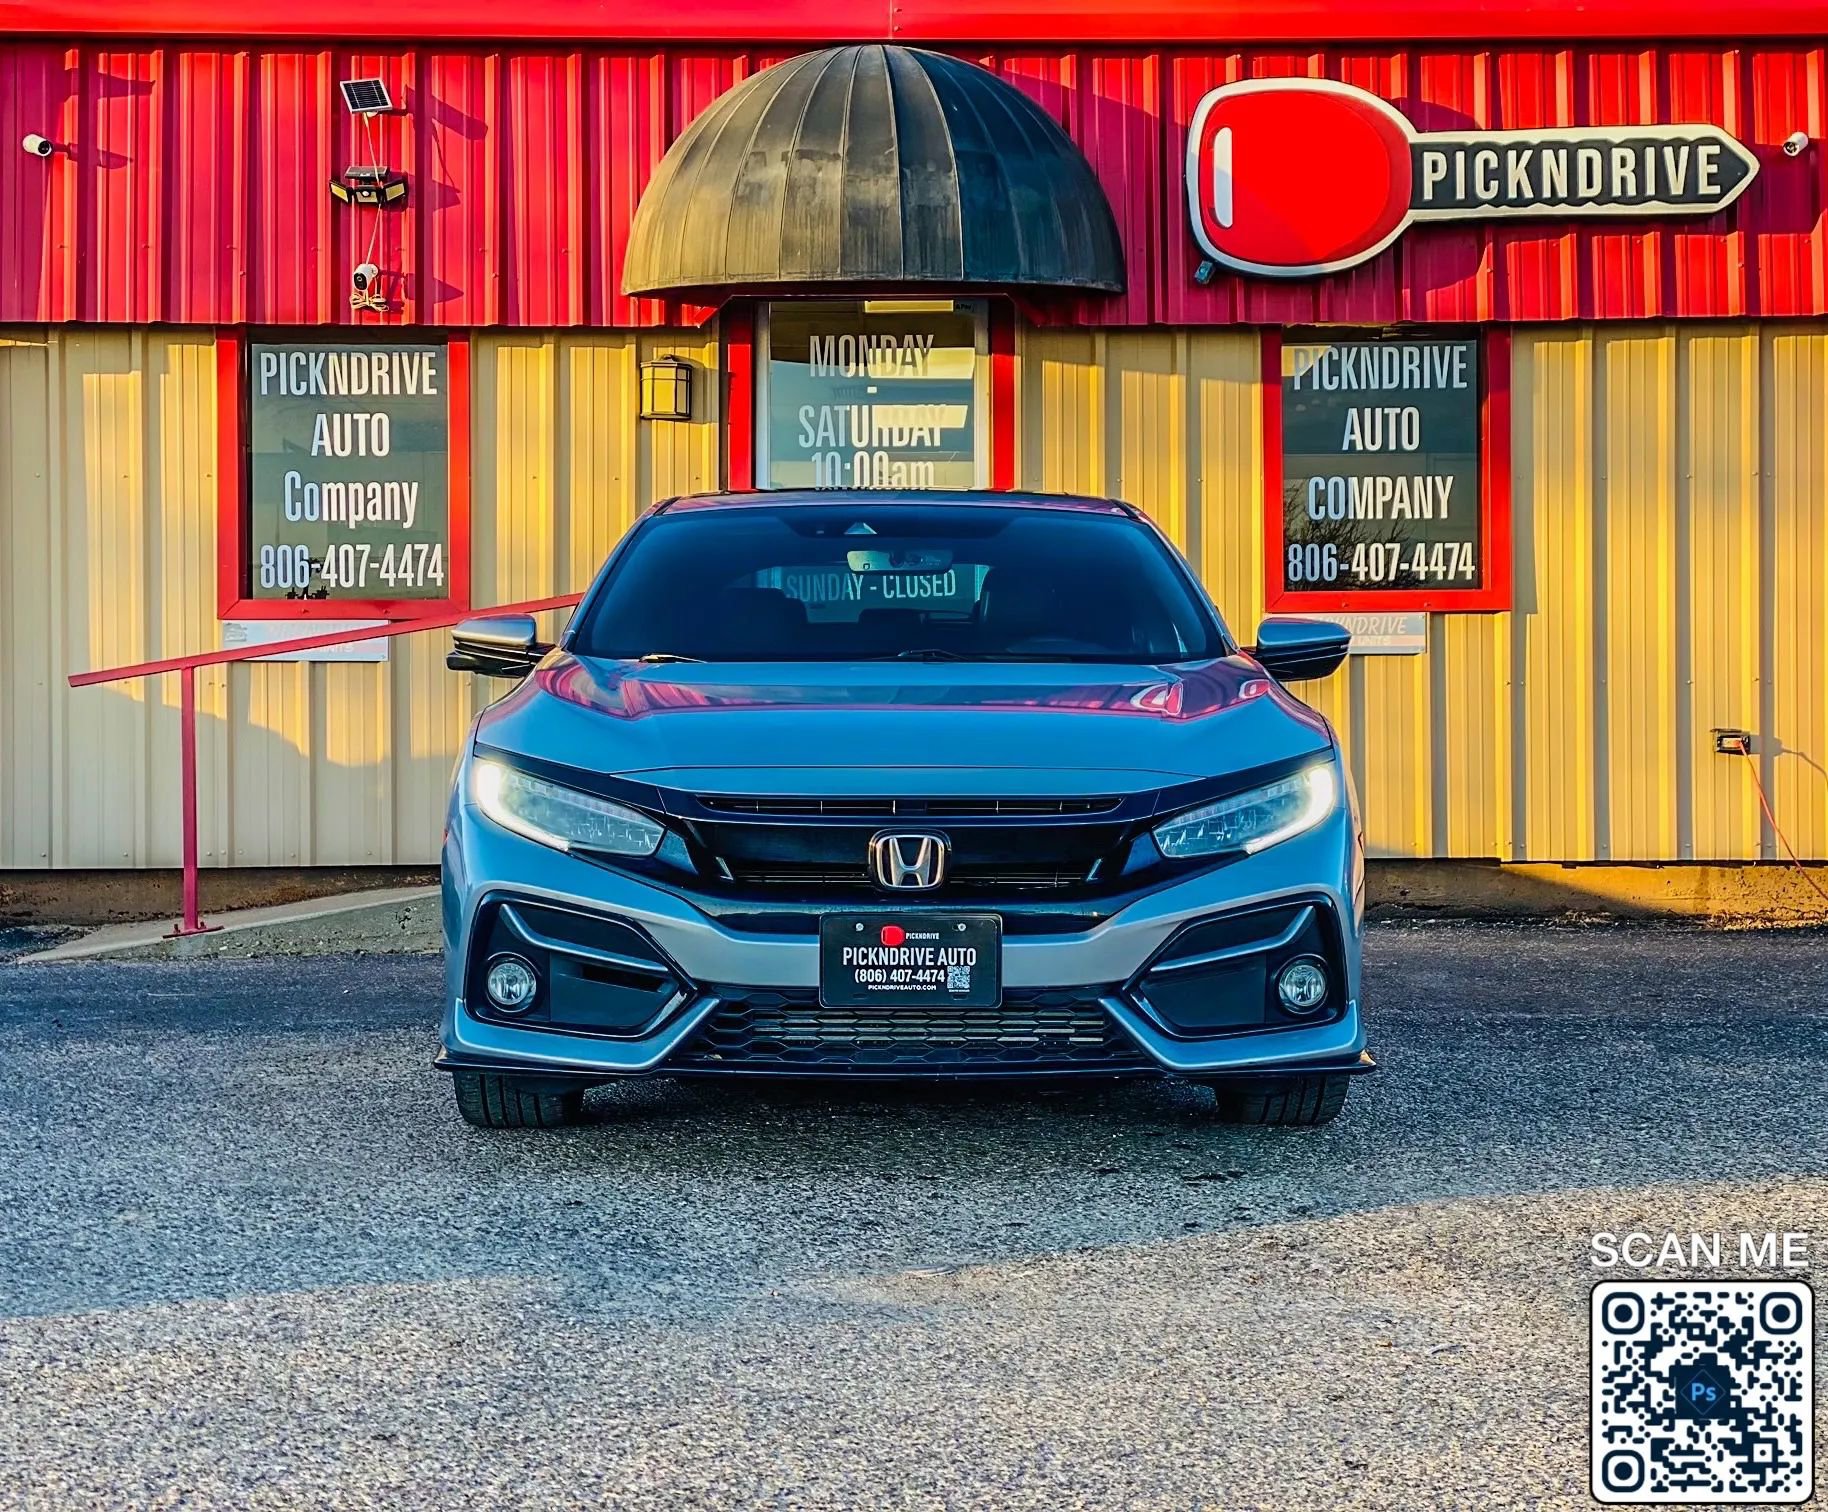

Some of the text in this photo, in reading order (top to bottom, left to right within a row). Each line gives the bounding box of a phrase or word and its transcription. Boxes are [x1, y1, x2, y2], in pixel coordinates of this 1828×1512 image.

[1423, 145, 1721, 200] PICKNDRIVE
[260, 351, 438, 396] PICKNDRIVE
[809, 334, 935, 378] MONDAY
[1293, 345, 1468, 391] PICKNDRIVE
[311, 413, 390, 457] AUTO
[798, 404, 948, 448] SATURDAY
[1342, 406, 1420, 451] AUTO
[284, 470, 419, 529] Company
[1308, 475, 1454, 520] COMPANY
[260, 543, 444, 588] 806-407-4474
[1288, 542, 1475, 582] 806-407-4474
[786, 573, 864, 602] SUNDAY
[883, 570, 956, 599] CLOSED
[843, 947, 977, 966] PICKNDRIVE AUTO
[905, 932, 940, 940] PICKNDRIVE
[854, 968, 945, 983] (806) 407-4474
